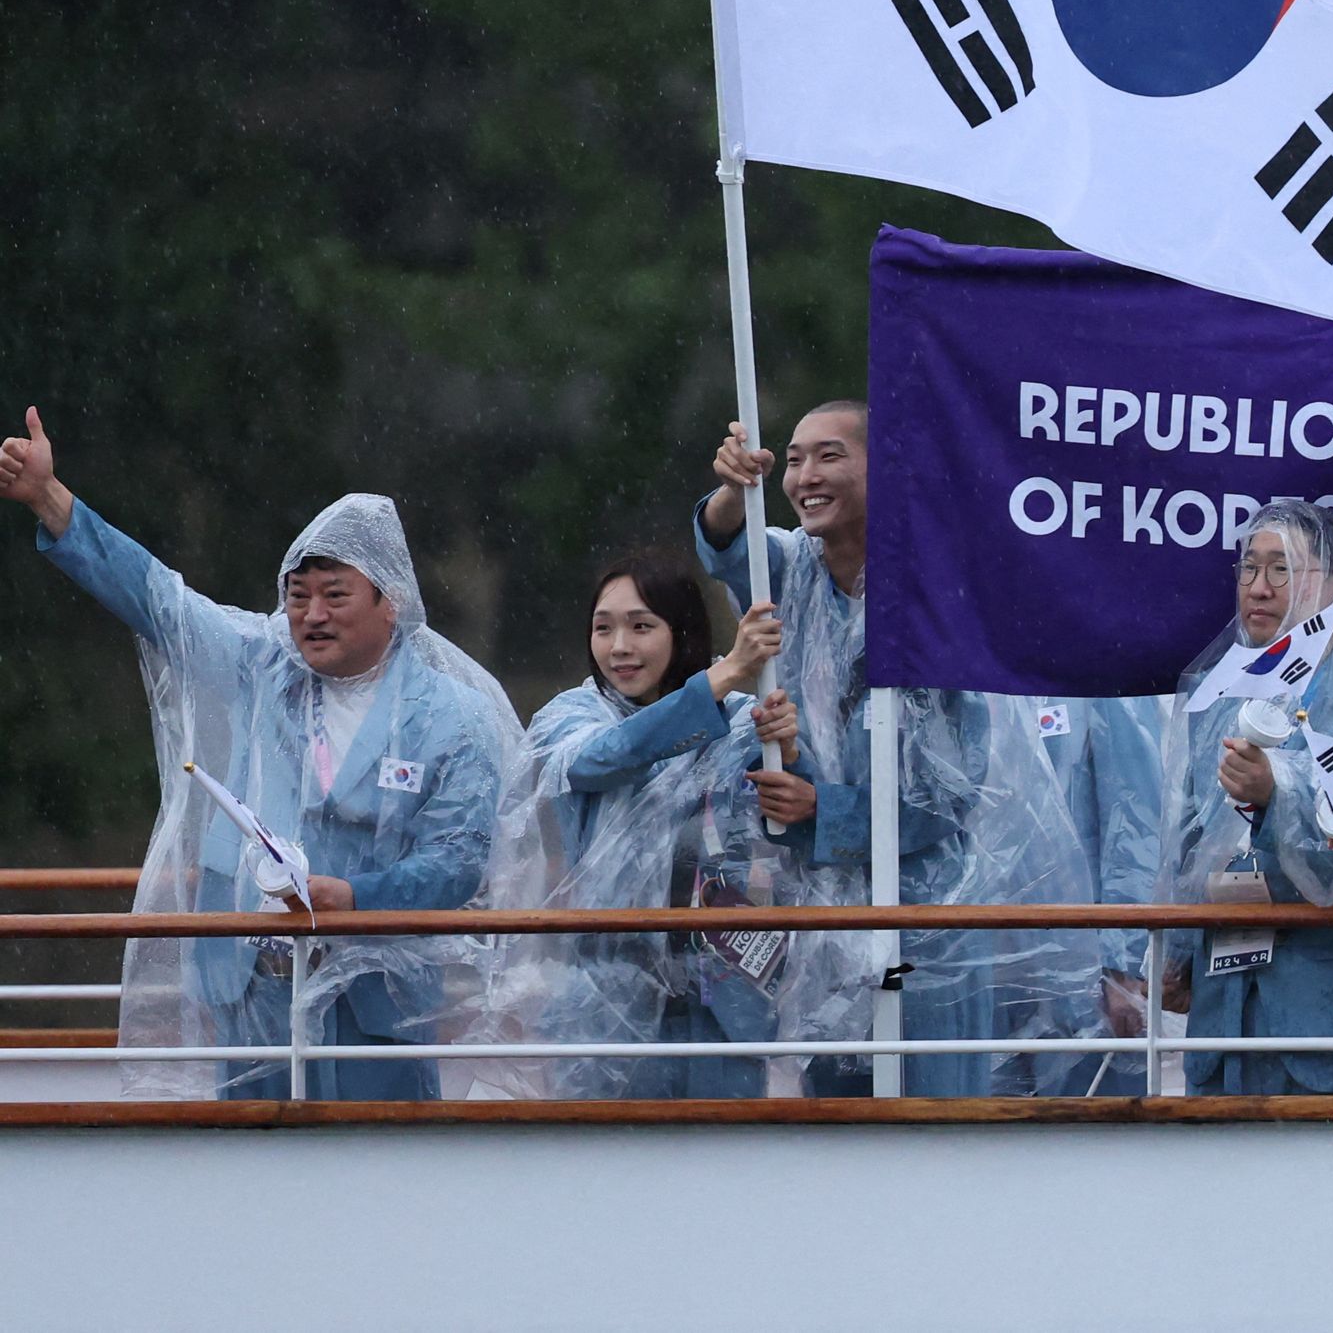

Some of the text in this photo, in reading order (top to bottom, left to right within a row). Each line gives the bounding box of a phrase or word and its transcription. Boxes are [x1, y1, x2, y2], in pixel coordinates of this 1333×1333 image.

[1008, 476, 1102, 538] OF
[736, 931, 753, 952] KO
[1215, 952, 1268, 969] H24 6R
